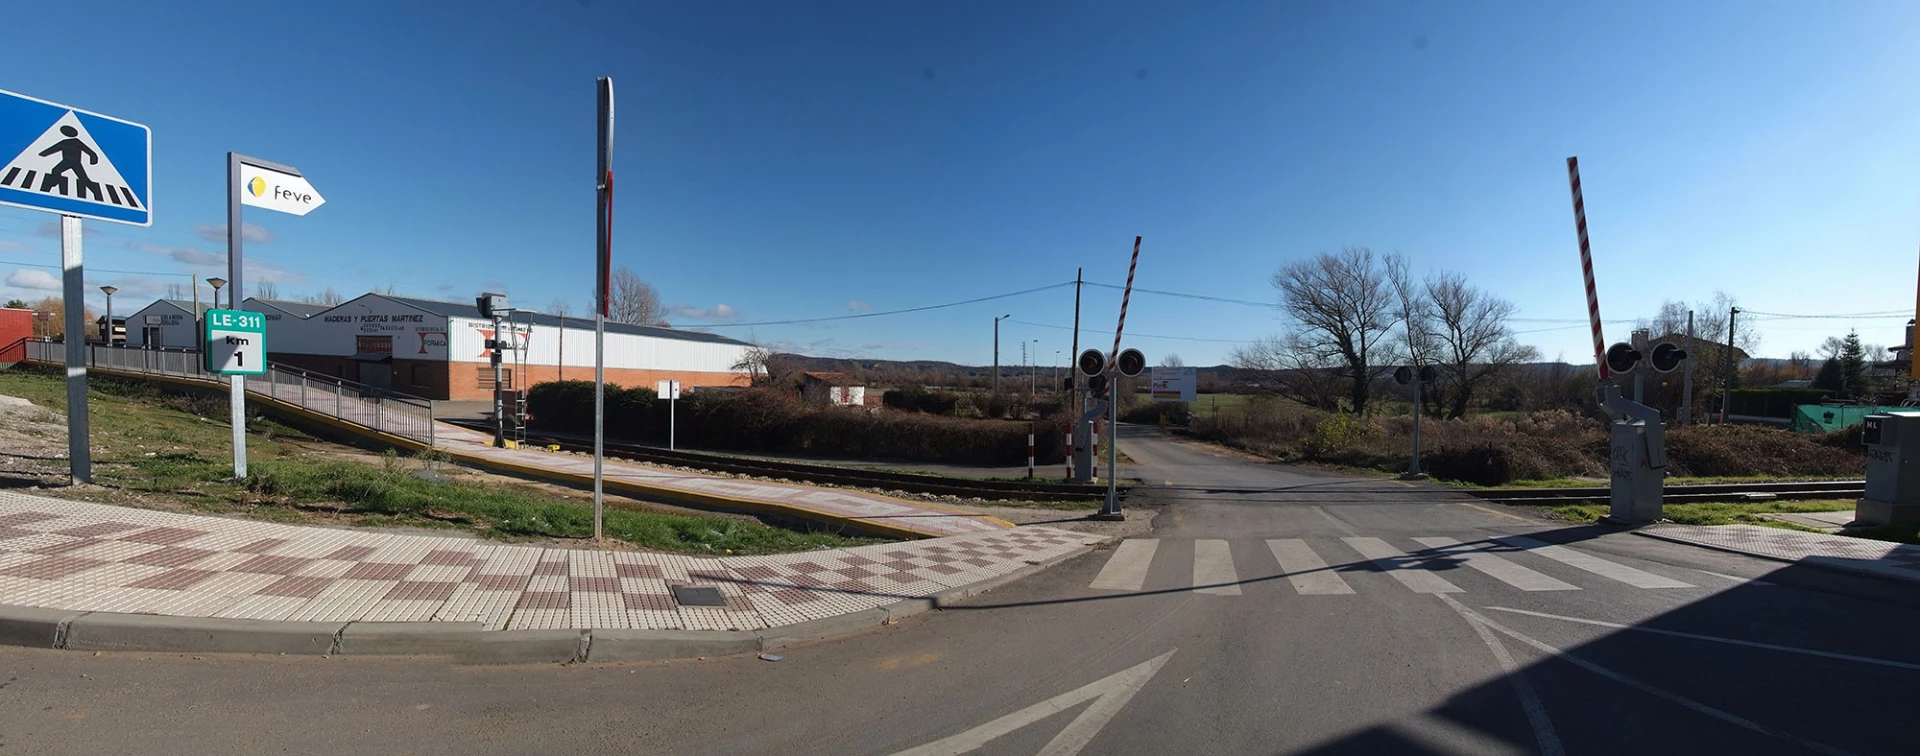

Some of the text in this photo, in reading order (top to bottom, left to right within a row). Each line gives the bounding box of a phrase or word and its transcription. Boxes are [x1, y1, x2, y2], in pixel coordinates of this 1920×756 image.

[274, 185, 312, 204] feve
[213, 313, 260, 328] LE-311
[226, 335, 249, 345] km
[234, 351, 243, 366] 1
